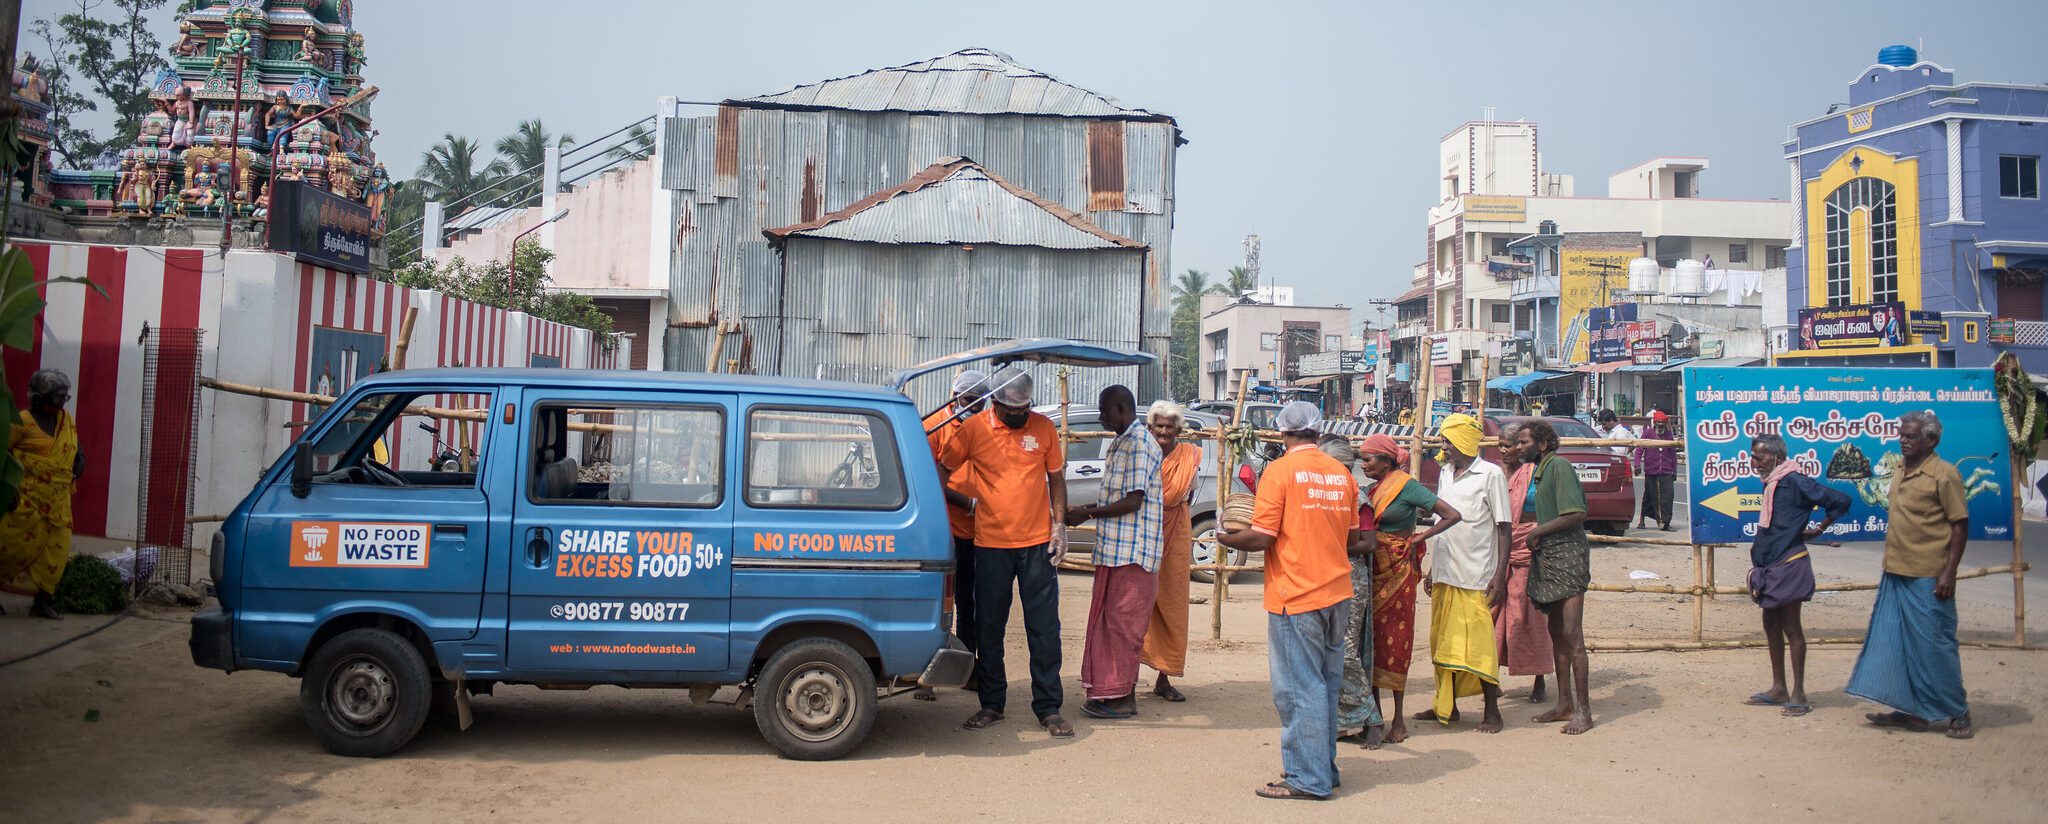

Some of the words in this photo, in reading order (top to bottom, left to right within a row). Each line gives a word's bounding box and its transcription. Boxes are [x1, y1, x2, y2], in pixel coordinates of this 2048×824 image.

[1814, 321, 1845, 338] ஜவுளி
[1846, 321, 1875, 334] கடை
[1696, 386, 1724, 402] மத்வ
[1697, 410, 1738, 443] ஸ்ரீ
[344, 529, 369, 541] NO
[374, 529, 420, 541] FOOD
[558, 529, 630, 553] SHARE
[636, 531, 693, 554] YOUR
[754, 532, 784, 551] NO
[789, 533, 835, 552] FOOD
[838, 535, 896, 553] WASTE
[344, 544, 419, 560] WASTE
[695, 543, 723, 569] 50+
[555, 555, 633, 578] EXCESS
[637, 554, 692, 577] FOOD
[564, 602, 625, 621] 90877
[629, 602, 690, 621] 90877
[550, 643, 573, 653] web
[582, 643, 696, 654] www.nofoodwaste.in
